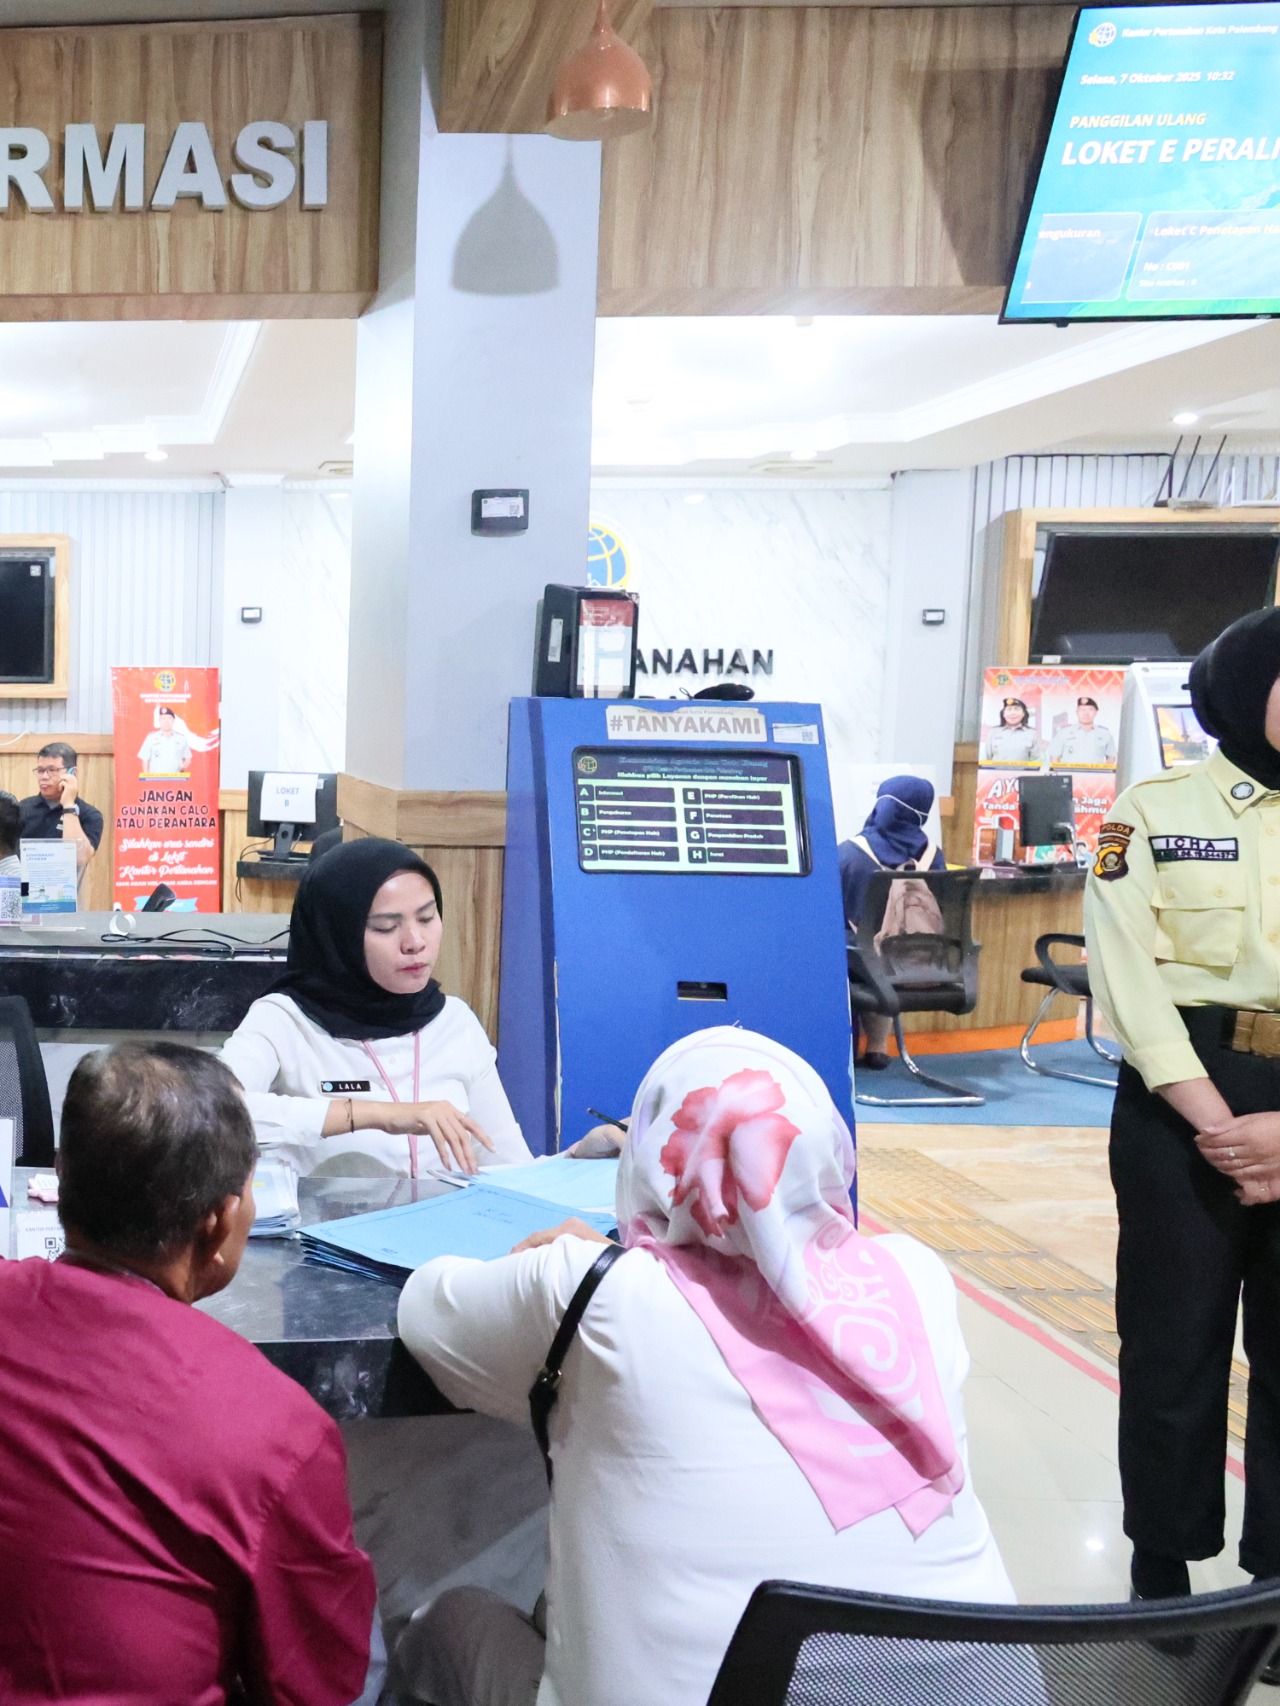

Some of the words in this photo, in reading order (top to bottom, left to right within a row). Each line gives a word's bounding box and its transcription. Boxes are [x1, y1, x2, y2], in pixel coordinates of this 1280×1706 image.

[1228, 24, 1278, 35] Palembang
[1120, 74, 1127, 84] 7
[1175, 72, 1201, 82] 2025
[1207, 71, 1235, 81] 10:32
[1069, 115, 1154, 129] PANGGILAN
[1156, 113, 1207, 126] ULANG
[1061, 140, 1155, 166] LOKET
[1158, 139, 1178, 163] E
[1154, 226, 1186, 237] Loket
[1188, 226, 1197, 236] C
[1199, 225, 1261, 237] Penetapan
[610, 714, 761, 735] #TANYAKAMI
[139, 790, 193, 802] JANGAN
[276, 787, 300, 795] LOKET
[580, 788, 589, 796] A
[687, 792, 695, 800] E
[982, 802, 1016, 811] Tanda
[1081, 797, 1108, 806] Jaga
[121, 806, 175, 816] GUNAKAN
[180, 805, 208, 816] CALO
[581, 808, 589, 816] B
[690, 812, 697, 820] F
[117, 818, 145, 829] ATAU
[149, 817, 216, 829] PERANTARA
[583, 828, 591, 836] C
[690, 831, 700, 839] G
[1101, 824, 1130, 835] POLDA
[119, 838, 162, 852] Silahkan
[184, 838, 214, 848] sendiri
[1166, 837, 1216, 851] ICHA
[148, 851, 159, 862] di
[161, 850, 188, 864] Loket
[584, 848, 593, 856] D
[692, 850, 702, 859] H
[119, 865, 157, 881] Kantor
[158, 864, 214, 879] Pertanahan
